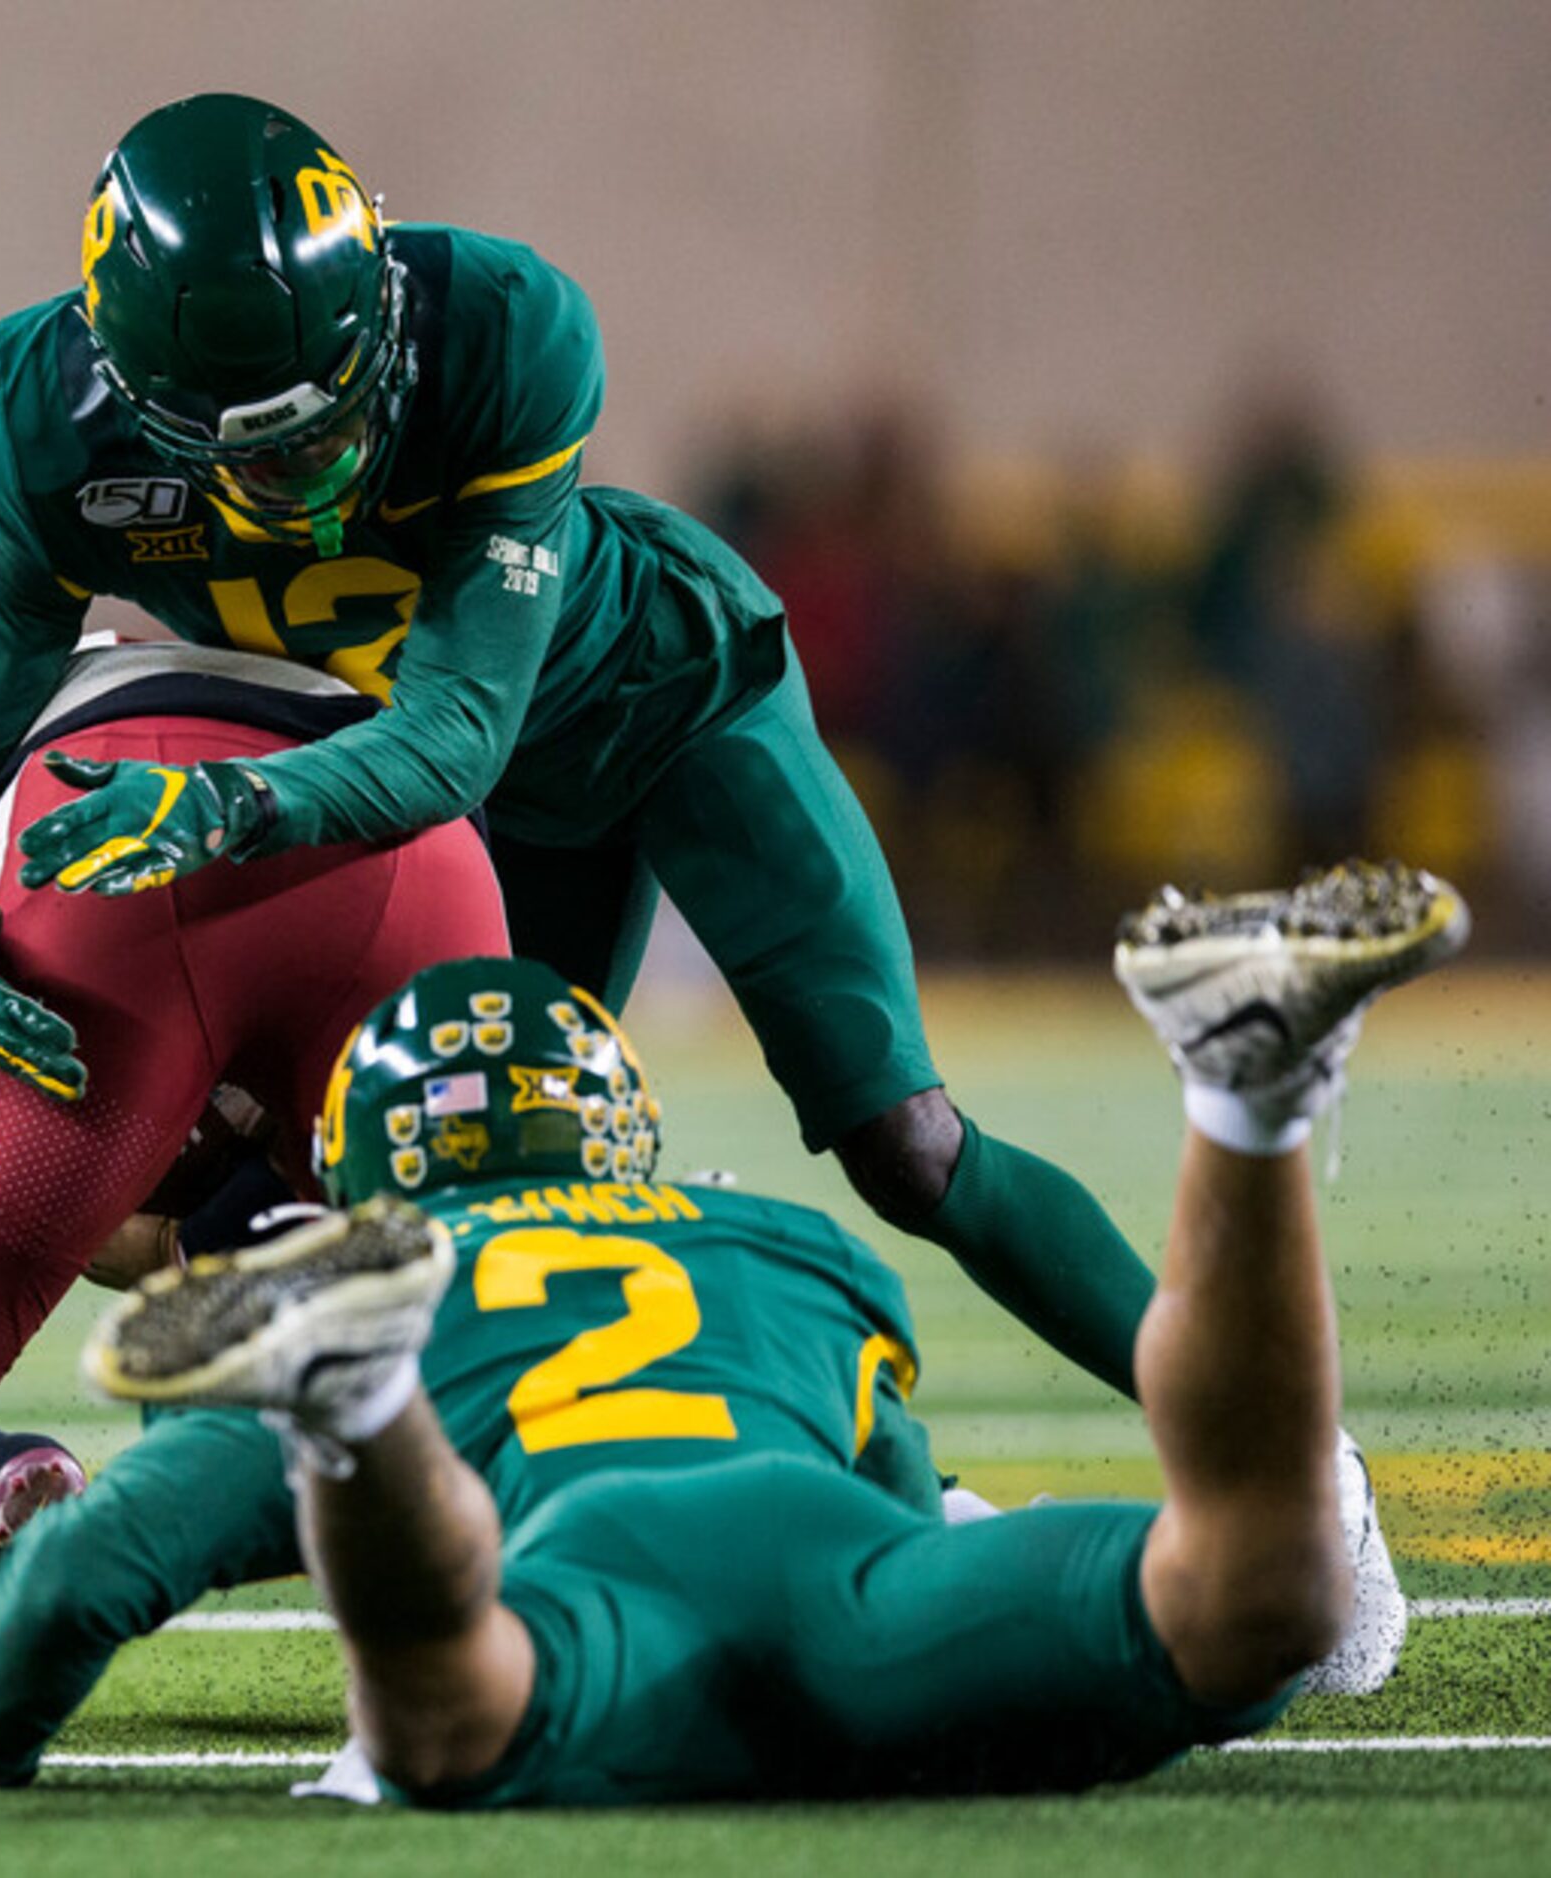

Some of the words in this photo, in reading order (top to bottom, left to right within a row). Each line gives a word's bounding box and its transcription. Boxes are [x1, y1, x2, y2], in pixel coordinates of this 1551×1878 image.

[242, 401, 298, 432] BEARS
[207, 556, 422, 709] 12
[473, 1226, 738, 1455] 2
